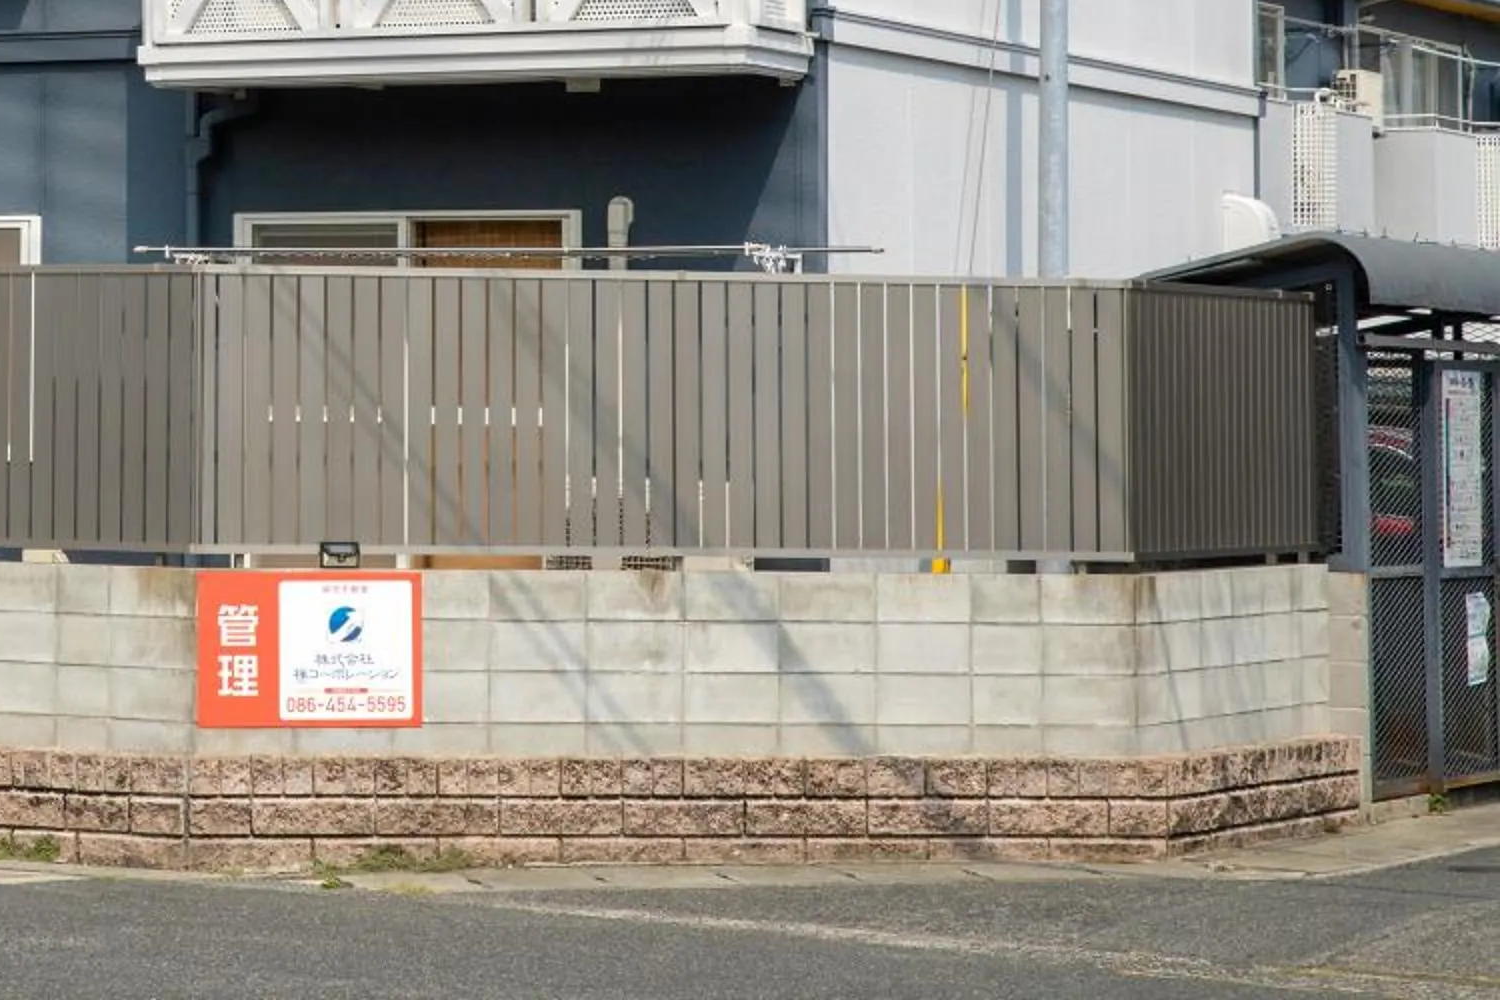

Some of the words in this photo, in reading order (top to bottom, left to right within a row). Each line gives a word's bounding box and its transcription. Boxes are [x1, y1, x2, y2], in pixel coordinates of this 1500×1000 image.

[217, 604, 259, 696] 管理
[314, 653, 375, 666] 株式会社
[286, 696, 407, 713] 086-454-5595
